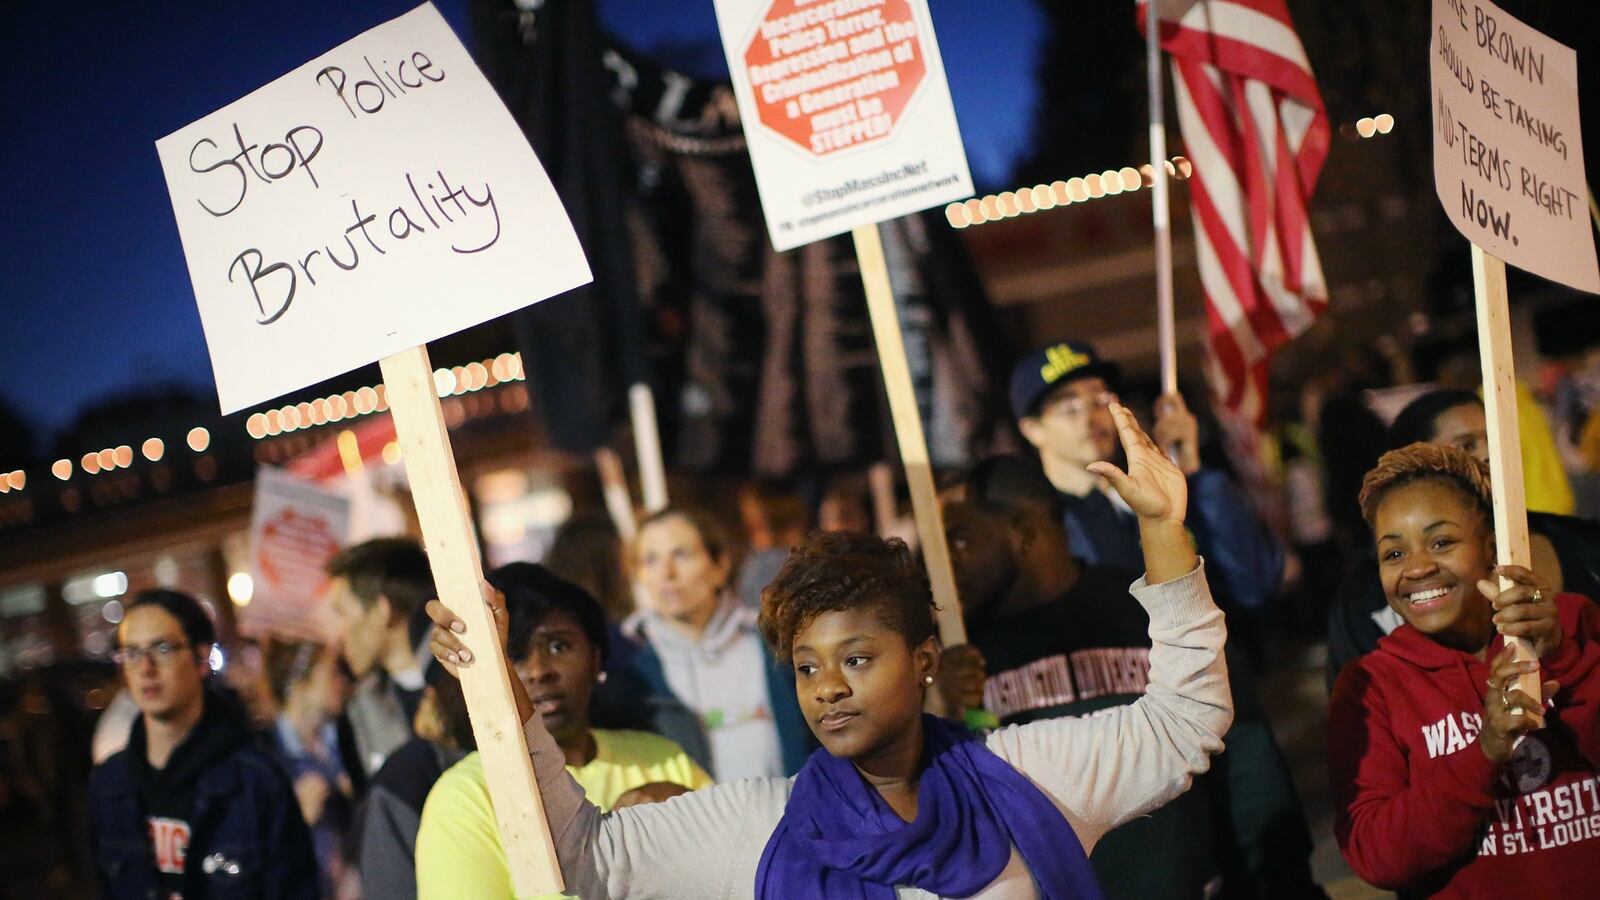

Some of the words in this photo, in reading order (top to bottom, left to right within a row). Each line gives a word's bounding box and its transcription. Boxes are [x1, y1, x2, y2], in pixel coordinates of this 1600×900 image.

[748, 40, 850, 86] Repression
[848, 27, 886, 55] and
[884, 20, 918, 44] the
[761, 48, 894, 104] Criminalization
[892, 40, 915, 64] of
[768, 26, 826, 59] Police
[1475, 5, 1545, 85] BROWN
[785, 100, 801, 120] a
[798, 70, 901, 115] Generation
[810, 102, 858, 134] must
[856, 96, 884, 120] be
[1438, 24, 1474, 94] SHOULD
[1480, 80, 1503, 120] BE
[1503, 98, 1568, 161] TAKING
[189, 122, 324, 217] Stop
[316, 51, 446, 119] Police
[1438, 88, 1512, 192] MID-TERMS
[1520, 166, 1580, 220] RIGHT
[1461, 179, 1520, 247] NOW.
[228, 170, 501, 325] Brutality
[1502, 831, 1535, 856] ST.
[1537, 814, 1600, 850] LOUIS
